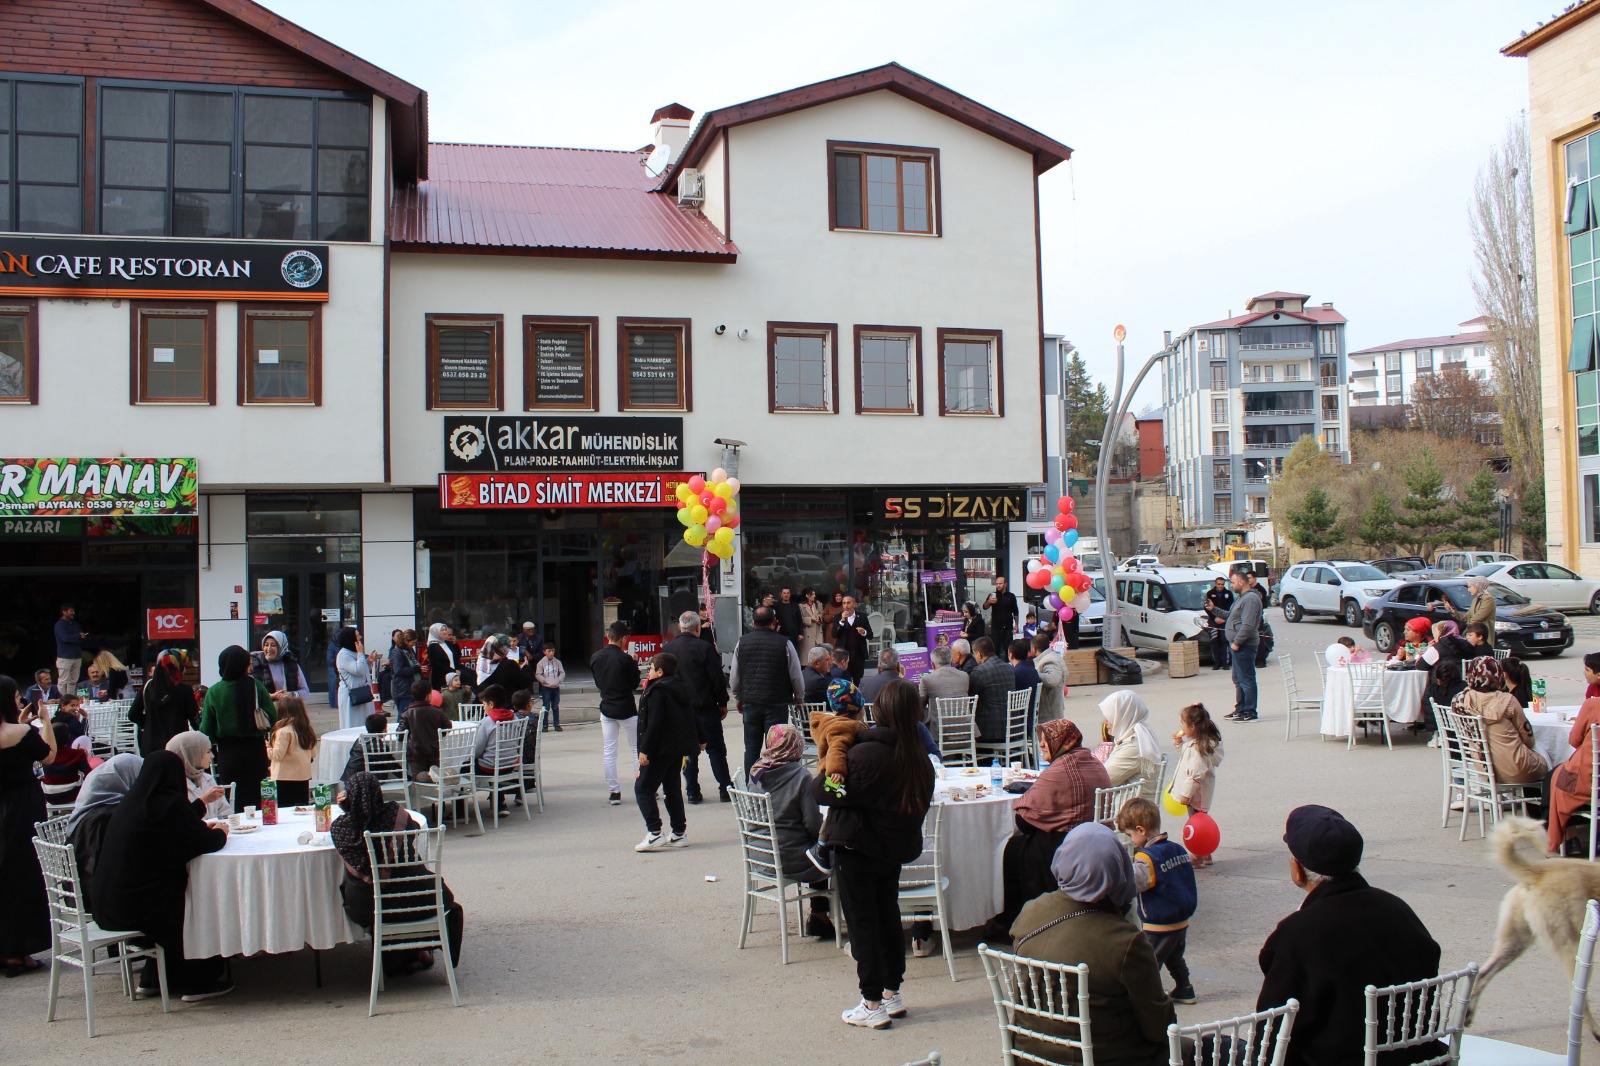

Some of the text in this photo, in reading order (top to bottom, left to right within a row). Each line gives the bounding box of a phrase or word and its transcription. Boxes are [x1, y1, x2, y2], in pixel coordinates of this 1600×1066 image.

[35, 255, 102, 279] CAFE
[109, 257, 251, 280] RESTORAN
[497, 420, 678, 450] akkar MÜHENDİSLİK
[39, 463, 183, 495] MANAV
[479, 475, 661, 504] BİTAD SİMİT MERKEZİ
[0, 500, 167, 510] Osman BAYRAK: 0536 972 49 58
[885, 497, 922, 519] SS
[4, 520, 61, 534] PAZARI
[635, 641, 656, 652] SİMİT
